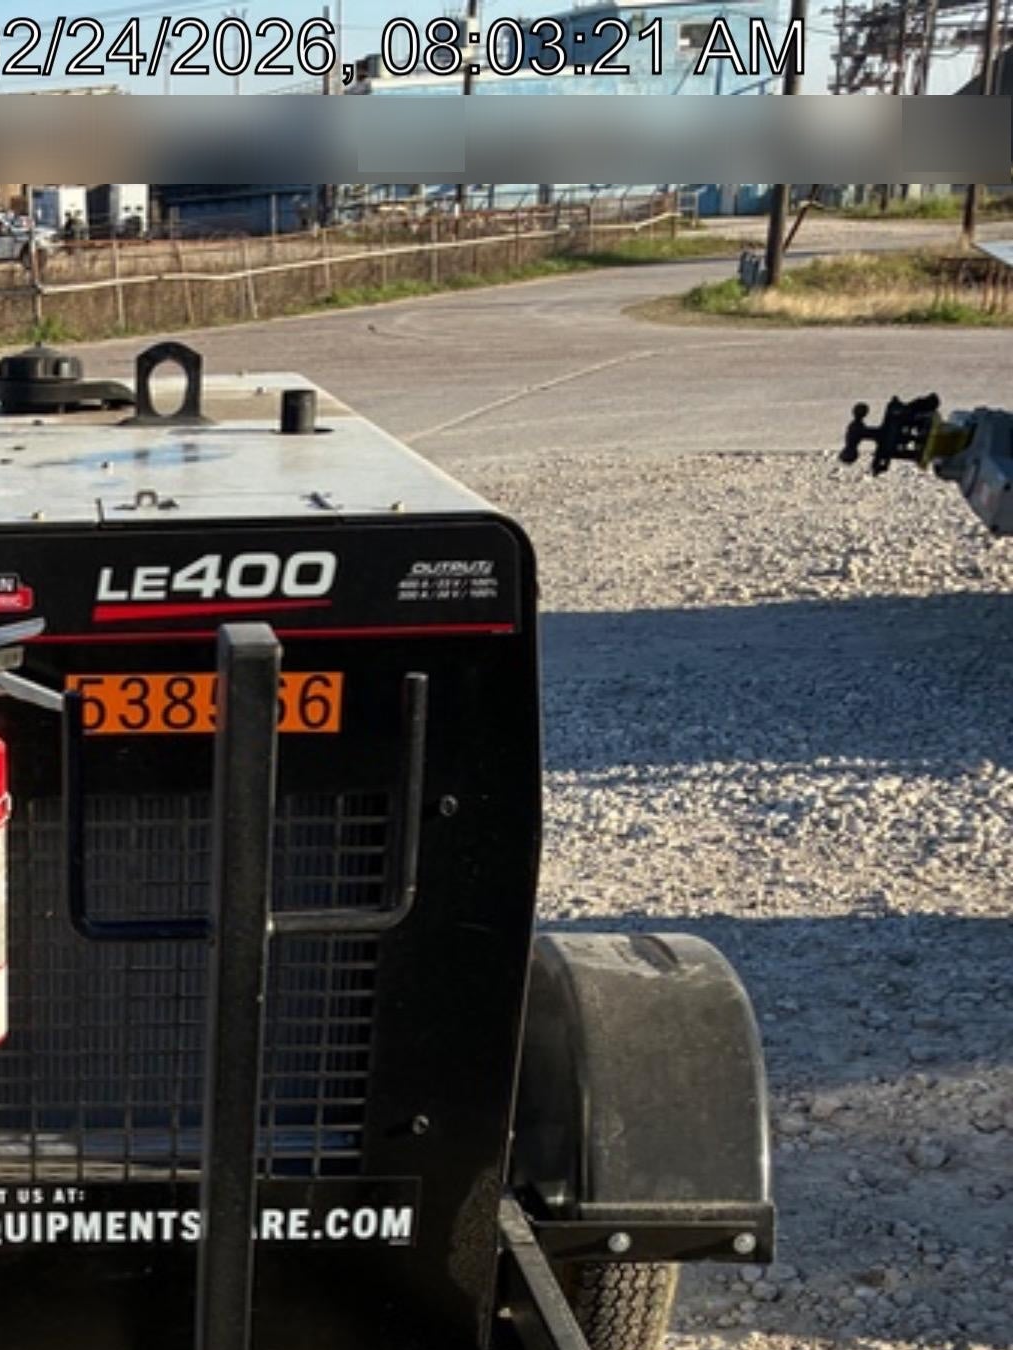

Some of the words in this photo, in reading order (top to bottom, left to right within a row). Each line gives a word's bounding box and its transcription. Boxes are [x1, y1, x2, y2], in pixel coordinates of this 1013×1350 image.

[96, 552, 336, 600] LE400
[77, 675, 332, 730] 5386
[17, 1190, 44, 1203] US
[53, 1188, 86, 1203] AT:
